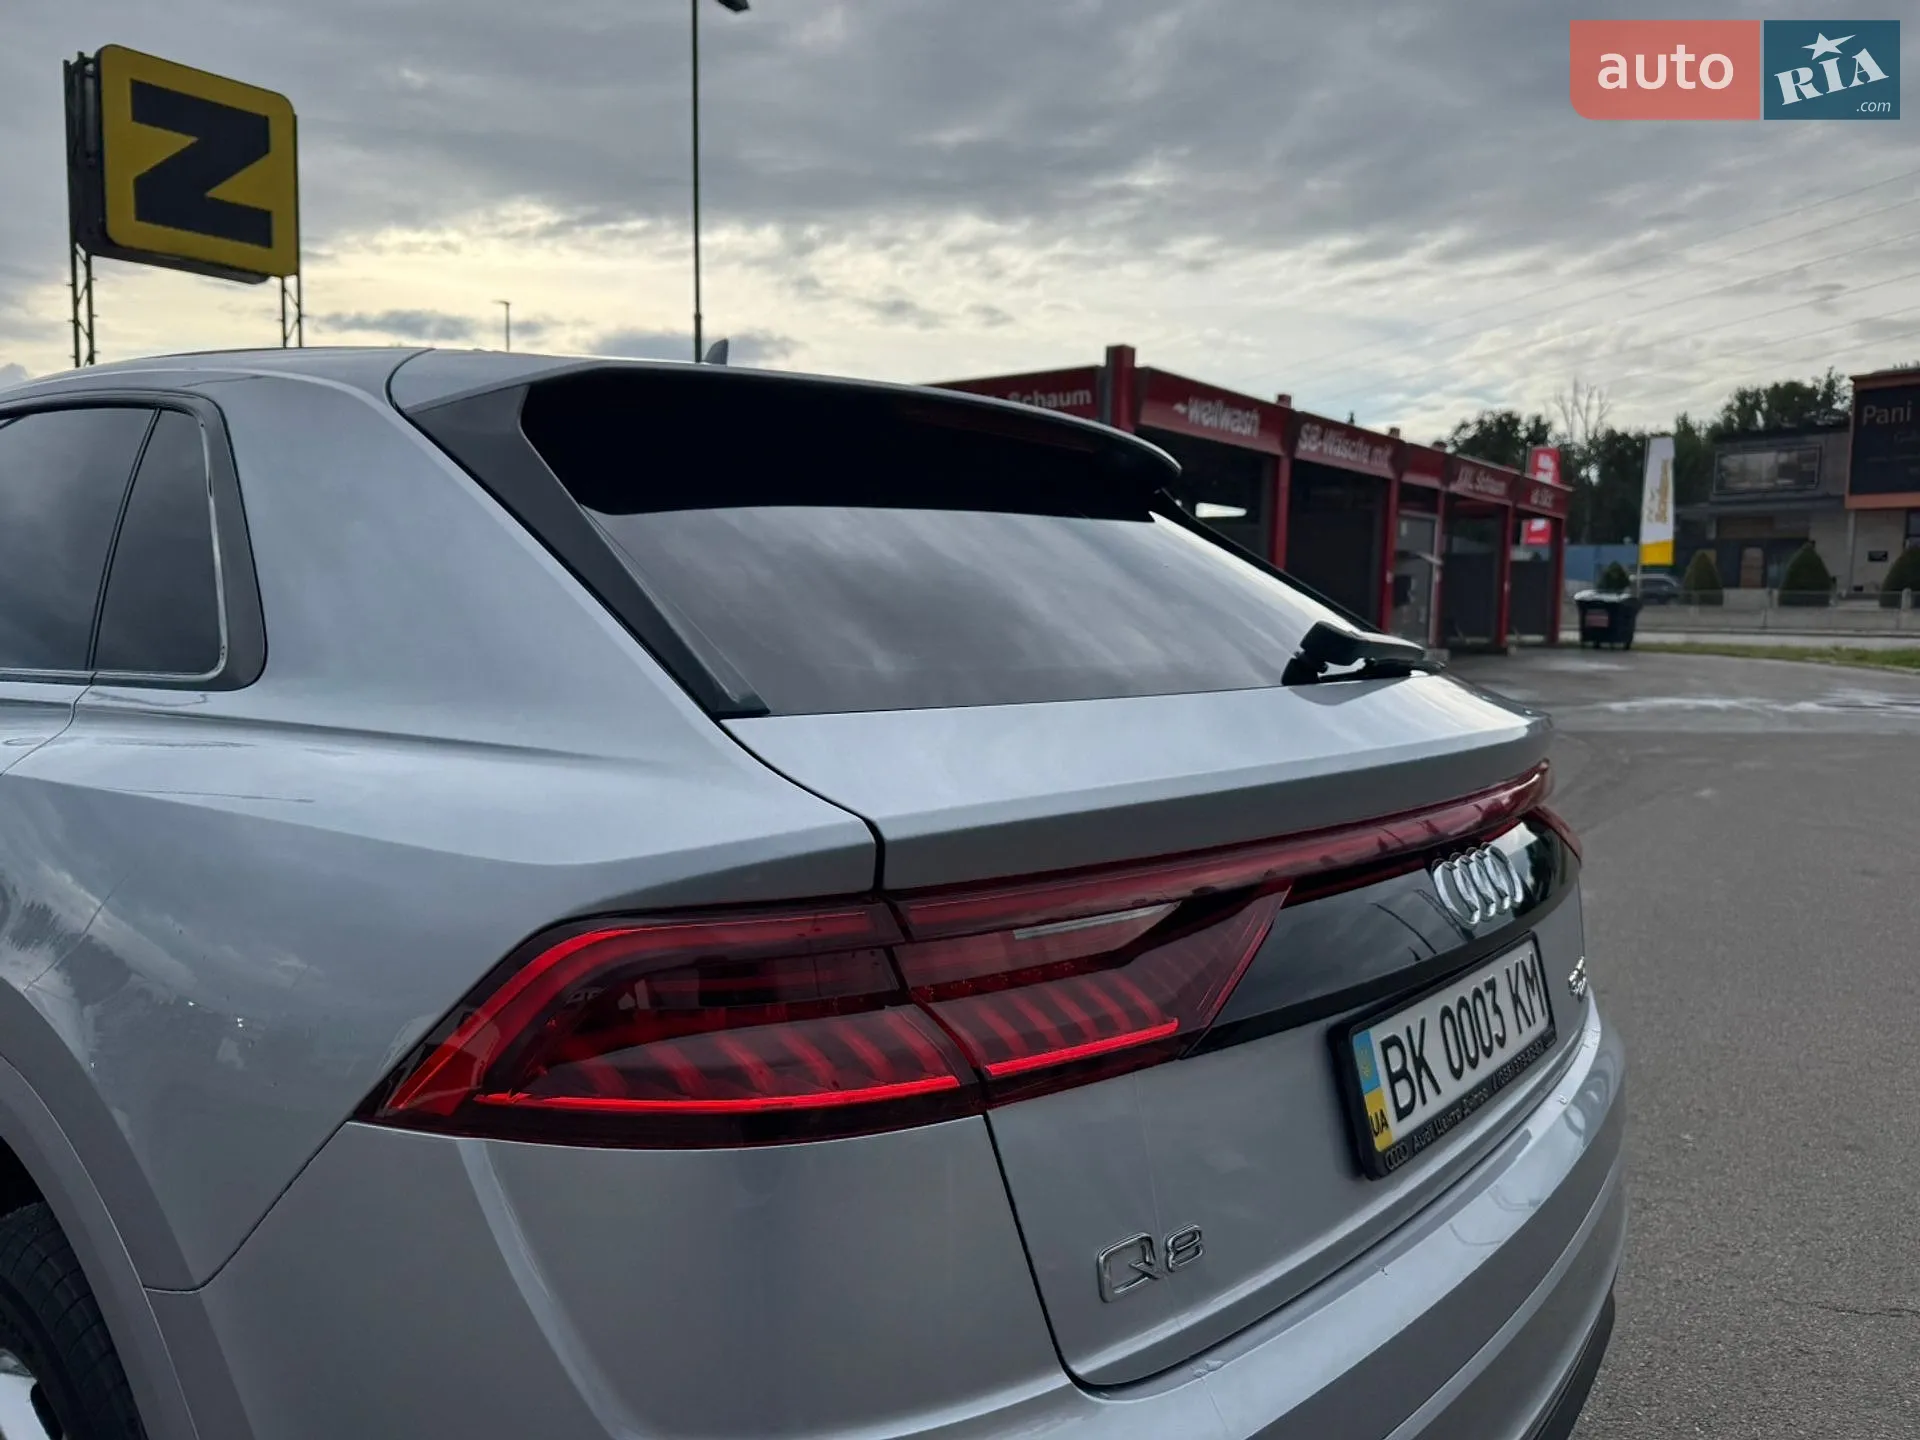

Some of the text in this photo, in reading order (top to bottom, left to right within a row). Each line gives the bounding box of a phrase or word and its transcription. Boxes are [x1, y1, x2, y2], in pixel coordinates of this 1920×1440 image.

[130, 78, 273, 249] Z
[1380, 1016, 1441, 1121] BK
[1439, 975, 1506, 1081] 0003
[1505, 951, 1546, 1035] KM
[1369, 1109, 1389, 1136] UA
[1097, 1224, 1203, 1302] Q8
